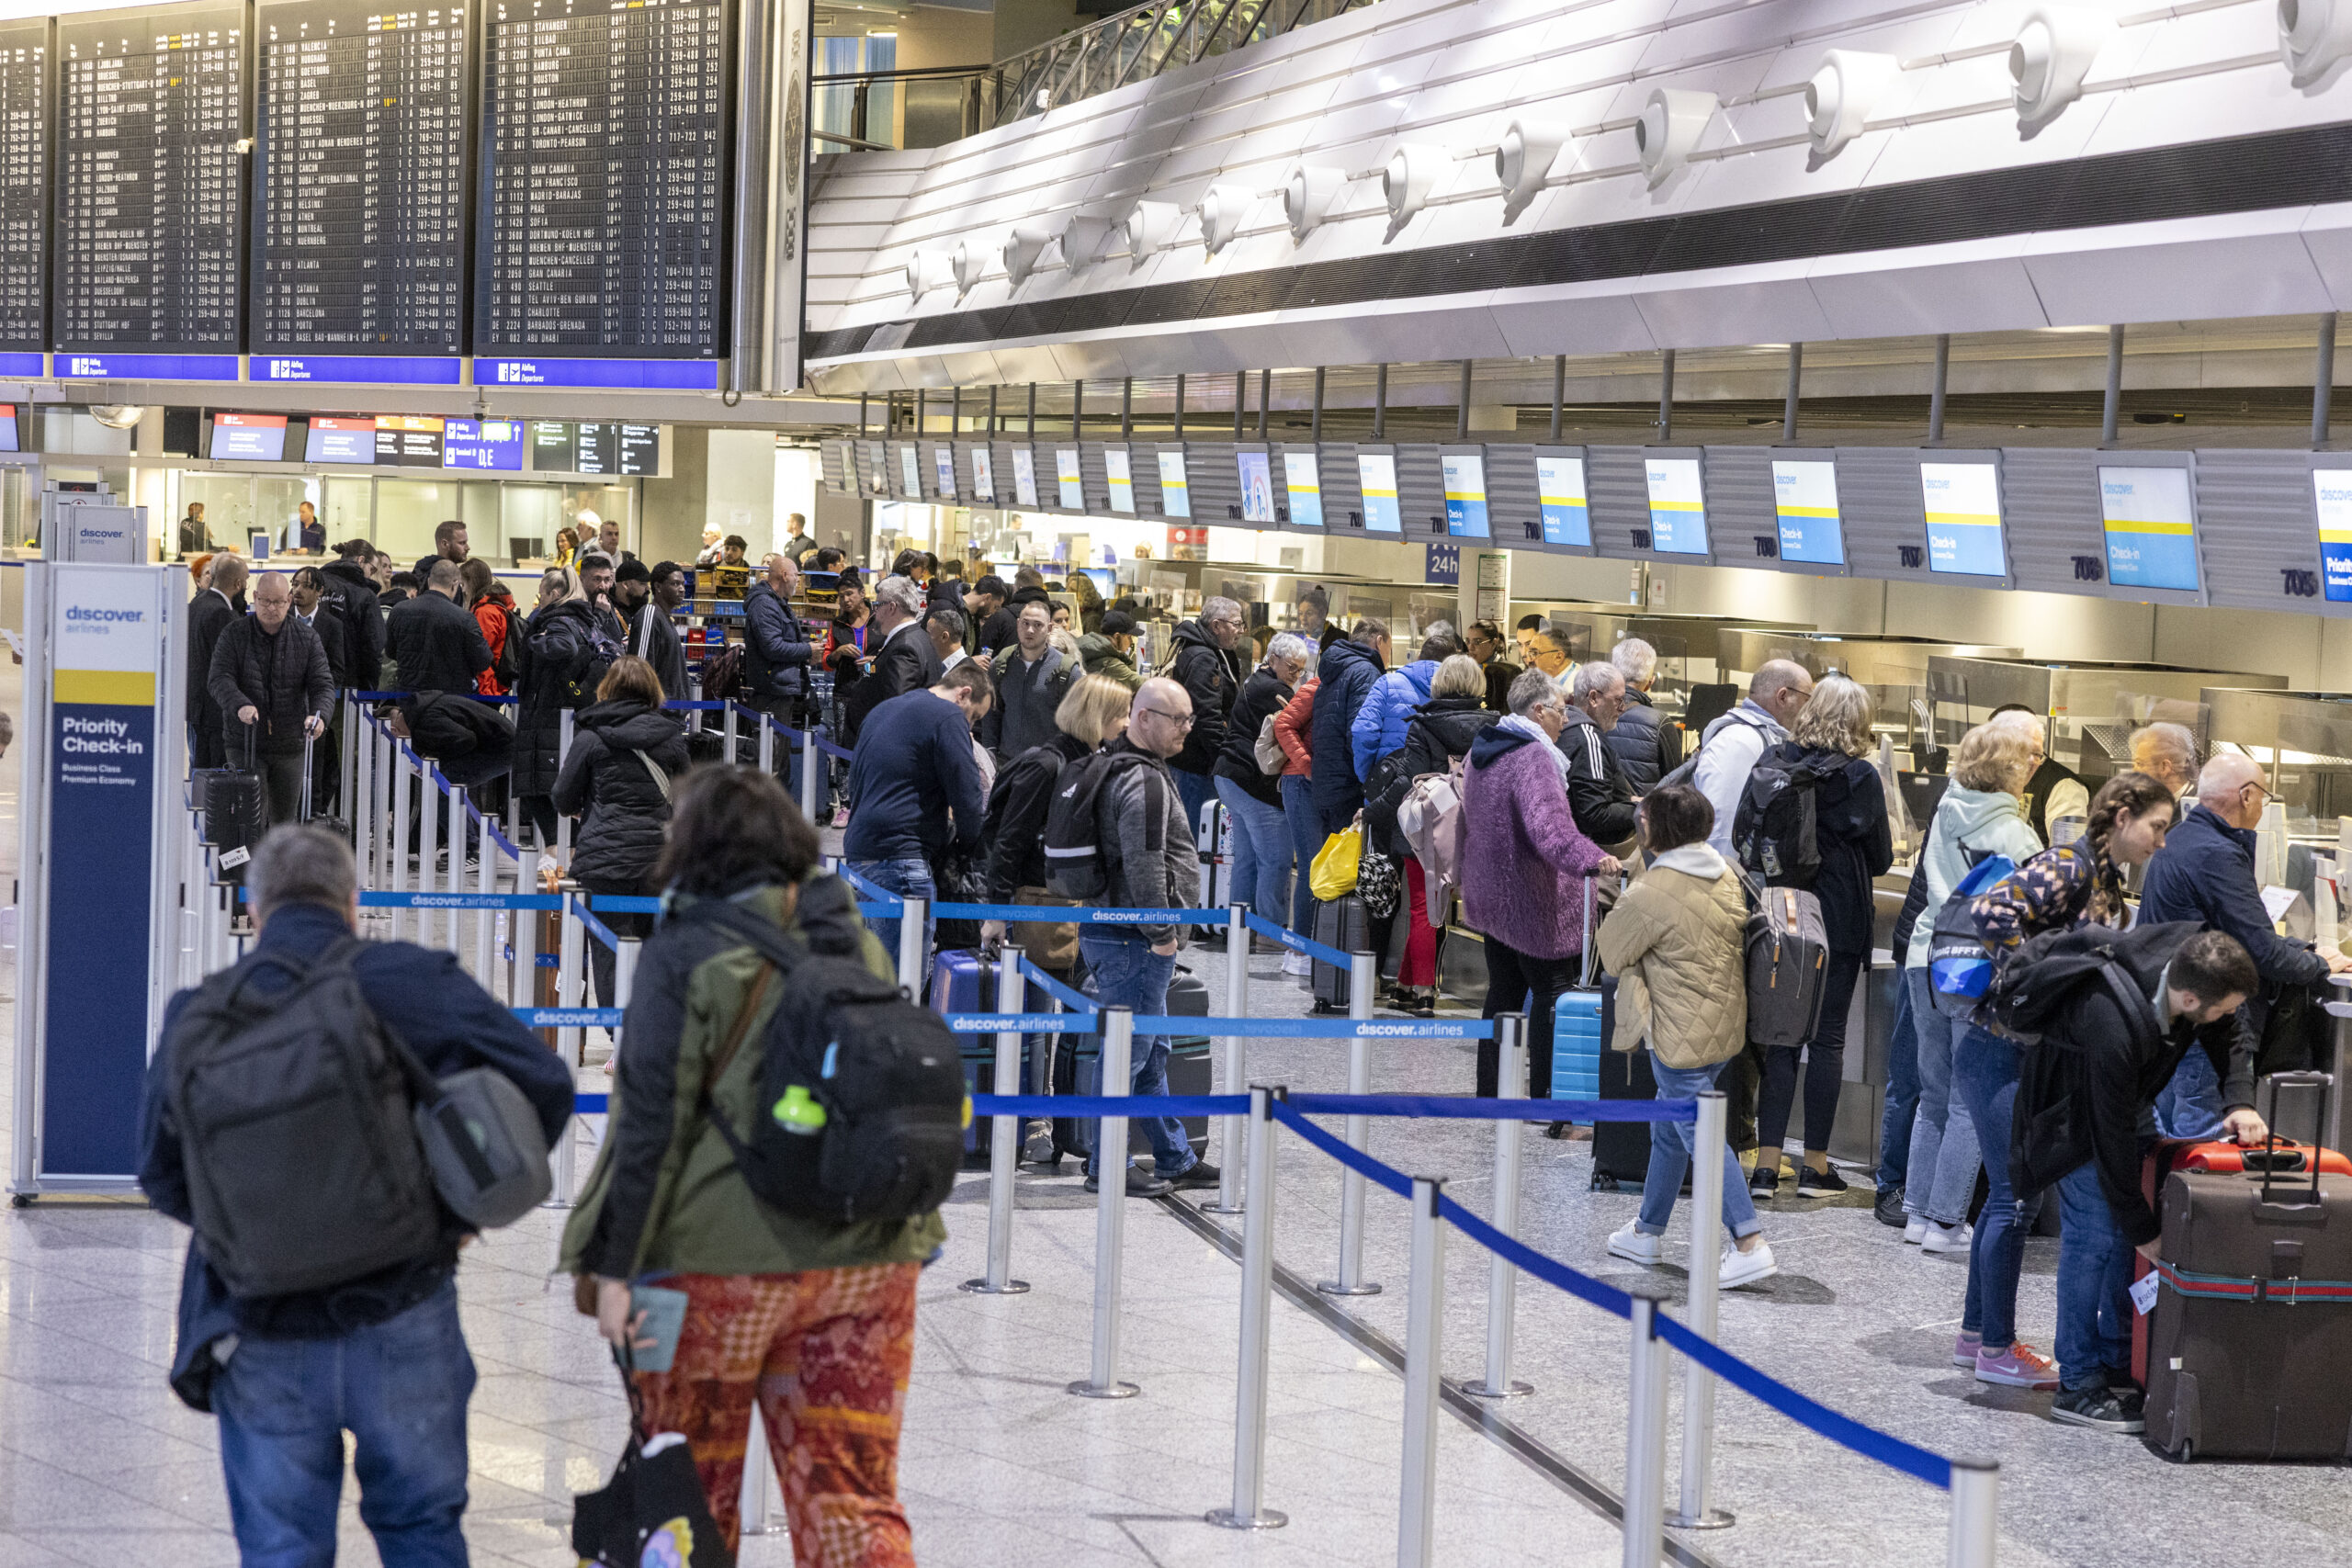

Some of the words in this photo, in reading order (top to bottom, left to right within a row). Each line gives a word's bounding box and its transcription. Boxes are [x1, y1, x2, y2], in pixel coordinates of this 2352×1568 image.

[535, 19, 568, 32] STAVANGER
[534, 34, 557, 45] BILBAO
[534, 48, 552, 59] PUNTA
[555, 46, 571, 56] CANA
[533, 60, 560, 72] HAMBURG
[533, 73, 560, 85] HOUSTON
[533, 86, 551, 97] MIAMI
[533, 111, 583, 123] LONDON-GATWICK
[532, 137, 587, 150] TORONTO-PEARSON
[669, 131, 696, 142] 717-722
[704, 130, 717, 141] B42
[299, 152, 306, 162] LA
[531, 165, 547, 175] GRAN
[549, 164, 575, 175] CANARIA
[668, 158, 695, 169] 259-488
[703, 157, 716, 167] A50
[531, 178, 542, 187] SAN
[545, 176, 579, 187] FRANCISCO
[668, 173, 695, 183] 259-488
[703, 171, 716, 181] Z23
[530, 190, 582, 201] MADRID-BARAJAS
[530, 205, 545, 214] PRAG
[667, 199, 695, 209] 259-488
[702, 198, 715, 209] A60
[529, 218, 548, 227] SOFIA
[583, 229, 595, 238] HBF
[529, 243, 551, 253] BREMEN
[297, 260, 320, 269] ATLANTA
[528, 254, 594, 265] MUENCHEN-CANCELLED
[528, 269, 544, 278] GRAN
[547, 268, 572, 277] CANARIA
[665, 266, 693, 276] 704-718
[700, 266, 712, 276] B12
[297, 284, 319, 294] CATANIA
[528, 281, 554, 291] SEATTLE
[665, 280, 693, 290] 259-488
[700, 280, 712, 289] Z25
[296, 297, 316, 306] DUBLIN
[528, 295, 538, 304] TEL
[542, 295, 571, 304] AVIV-BEN
[574, 295, 597, 304] GURION
[296, 309, 325, 318] BARCELONA
[527, 308, 560, 317] CHARLOTTE
[664, 307, 692, 317] 959-968
[296, 321, 312, 330] PORTO
[527, 321, 585, 330] BARBADOS-GRENADA
[296, 333, 311, 342] BASEL
[527, 333, 538, 343] ABU
[541, 333, 560, 343] DHABI
[664, 334, 691, 344] 863-868
[2320, 486, 2352, 502] discove
[1430, 556, 1459, 574] 24h
[64, 622, 110, 636] airlines
[62, 716, 129, 738] Priority
[62, 736, 143, 755] Check-in
[62, 762, 97, 773] Business
[98, 762, 121, 774] Class
[62, 774, 98, 784] Premium
[98, 775, 136, 787] Economy
